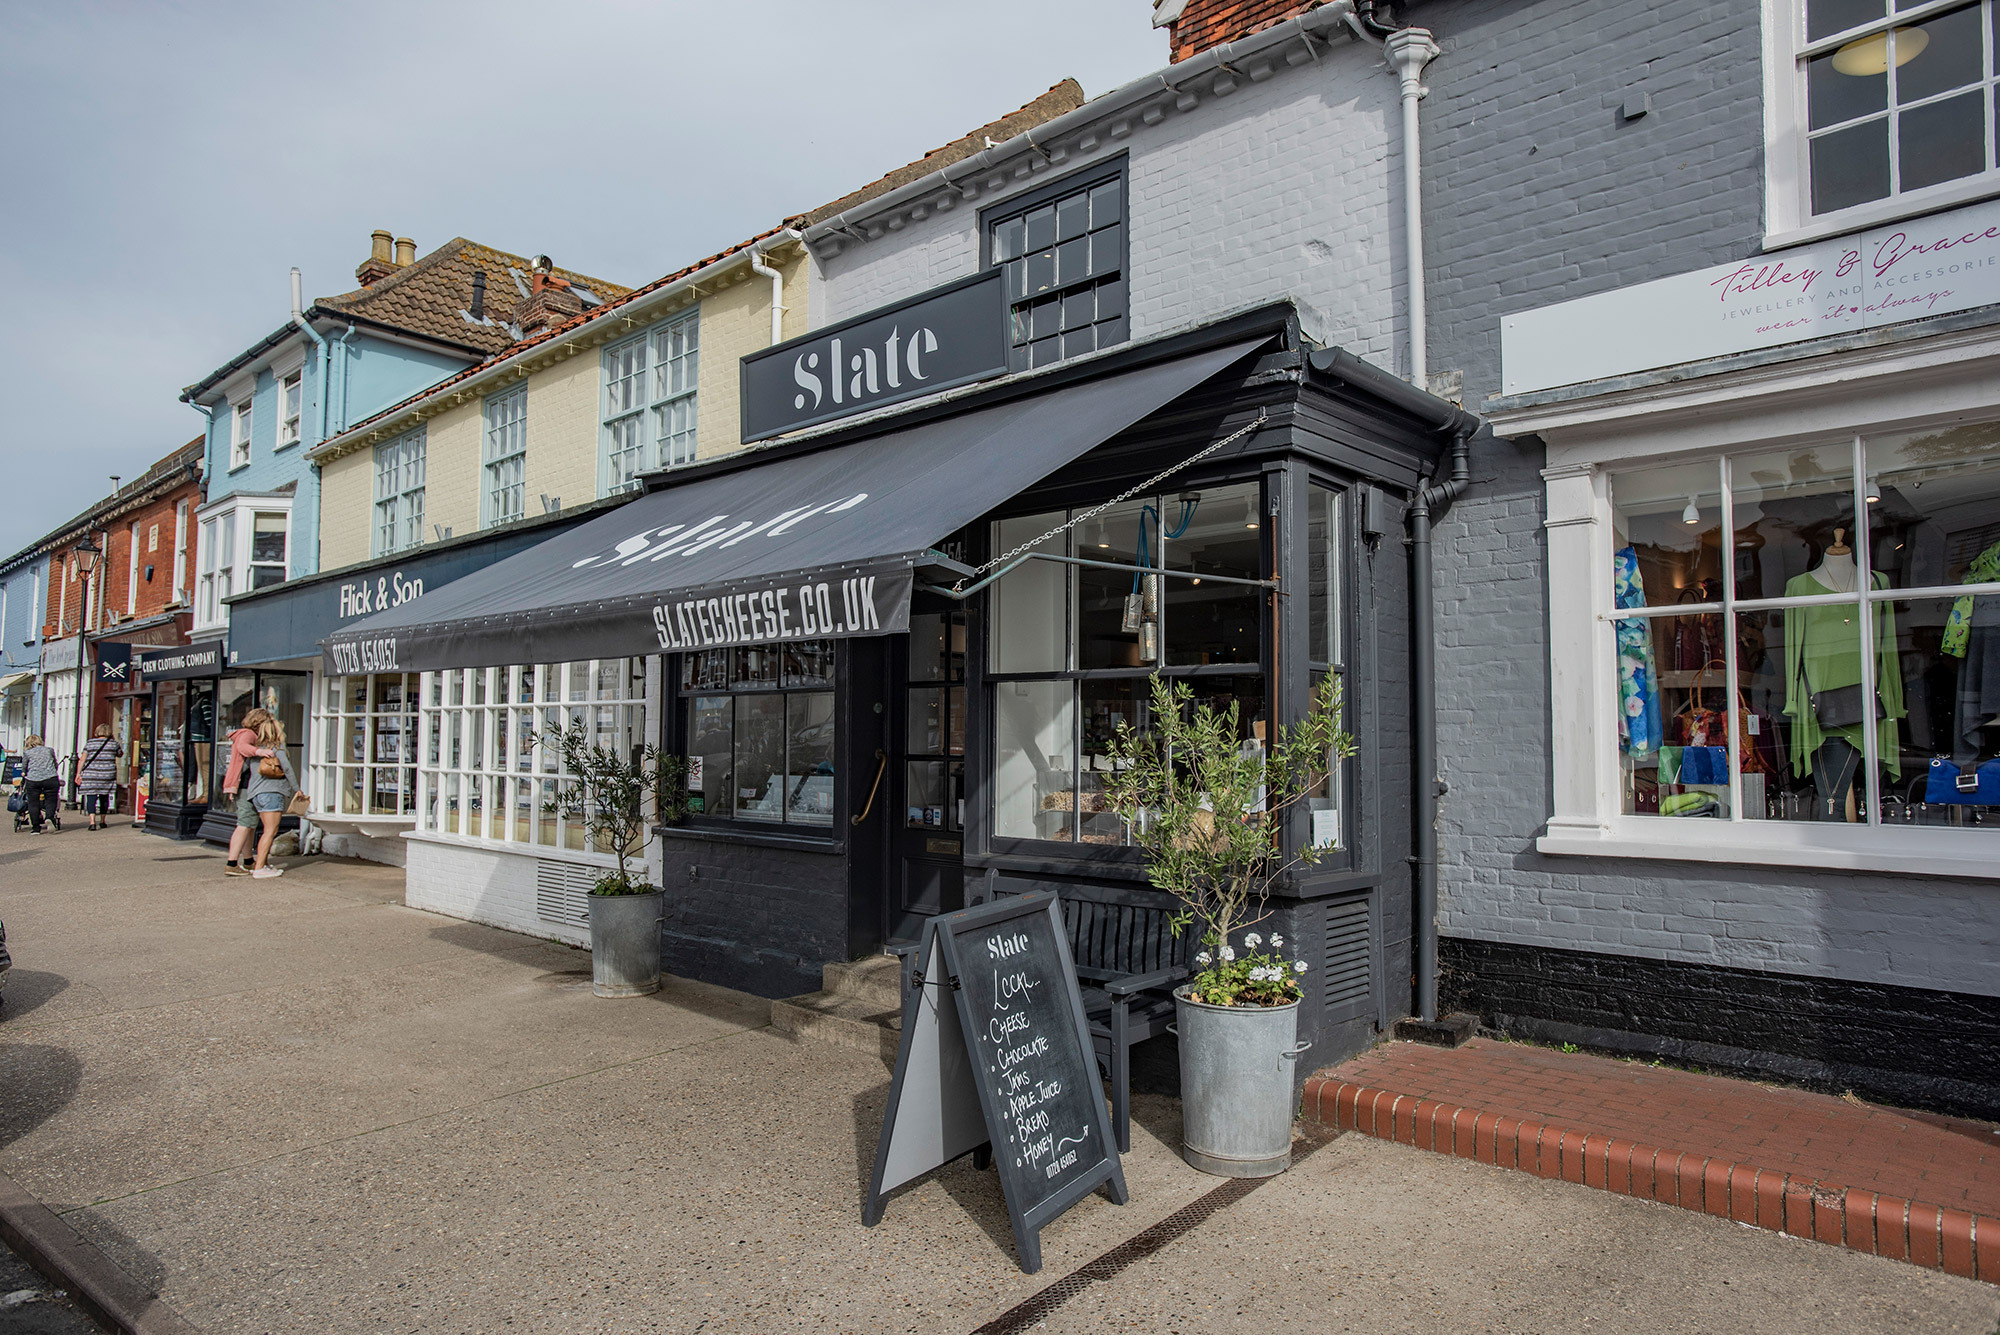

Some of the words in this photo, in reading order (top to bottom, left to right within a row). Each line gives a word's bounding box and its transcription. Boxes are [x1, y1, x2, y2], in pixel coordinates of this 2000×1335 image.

[1710, 262, 1823, 302] Tilley
[1835, 250, 1861, 278] &
[1873, 226, 2000, 278] Grace
[1721, 293, 1817, 321] JEWELLERY
[1826, 285, 1863, 300] AND
[1754, 316, 1814, 334] wear
[1821, 303, 1845, 320] it
[1862, 289, 1955, 313] always
[794, 324, 938, 411] Slate
[571, 493, 868, 569] Slate
[340, 580, 373, 618] Flick
[375, 576, 389, 612] &
[392, 571, 424, 607] Son
[652, 576, 880, 649] SLATECHEESE.CO.UK
[142, 660, 157, 673] CREW
[158, 655, 185, 671] CLOTHING
[186, 650, 216, 667] COMPANY
[332, 641, 360, 674] 01728
[361, 638, 400, 672] 454052
[986, 932, 1029, 959] Slate
[989, 1011, 1030, 1047] CHEESE
[997, 1035, 1049, 1070] CHOCOLATE
[1002, 1068, 1031, 1095] JAMS
[1010, 1091, 1037, 1119] APPLE
[1035, 1080, 1062, 1103] JUICE
[1015, 1110, 1050, 1143] BREAD
[1023, 1132, 1056, 1171] HONEY
[1045, 1160, 1061, 1179] 01728
